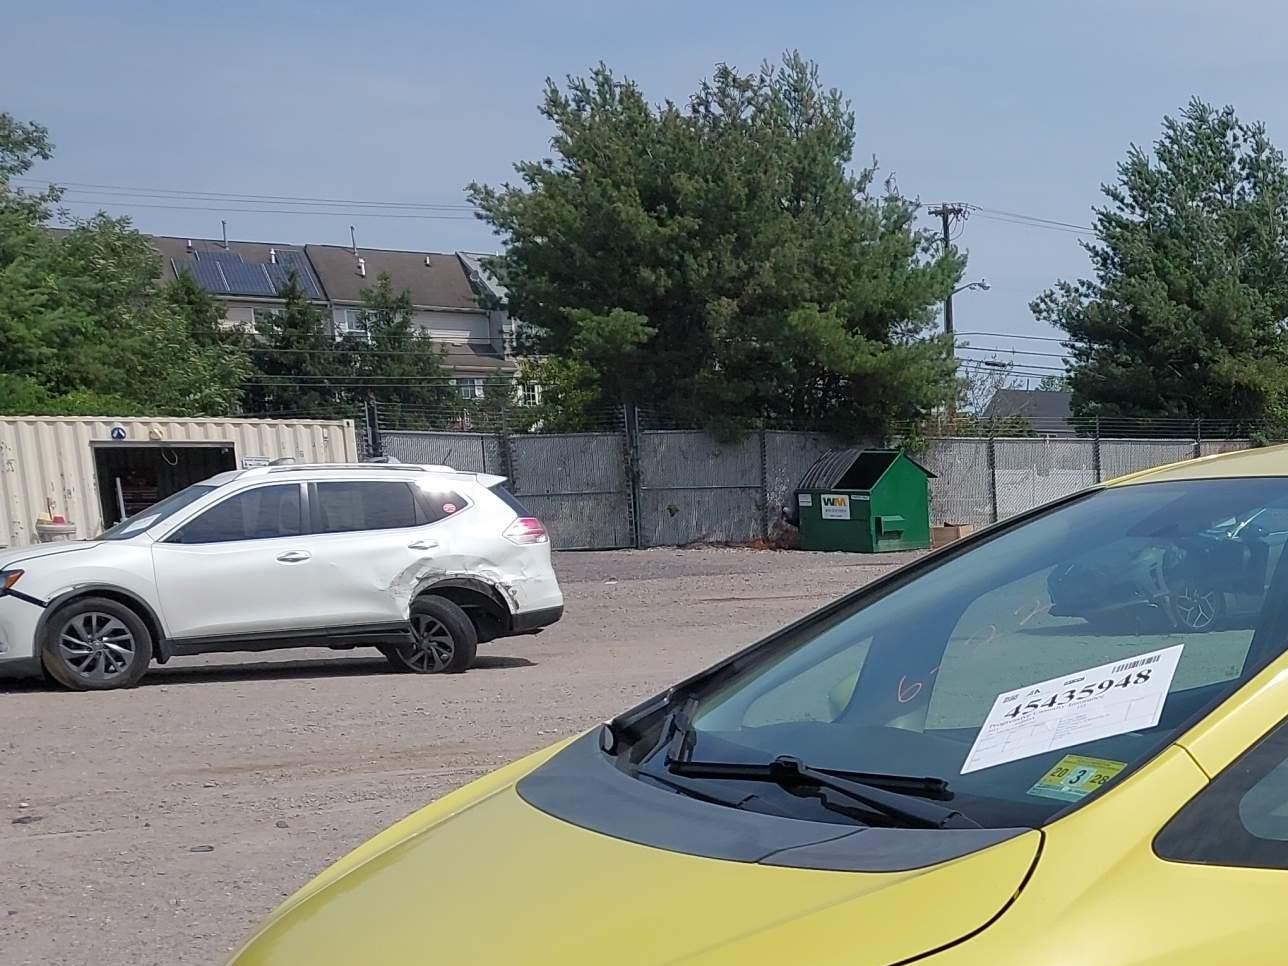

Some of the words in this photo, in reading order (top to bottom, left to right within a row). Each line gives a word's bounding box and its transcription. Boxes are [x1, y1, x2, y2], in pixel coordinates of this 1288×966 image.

[823, 497, 847, 507] WM
[1004, 668, 1152, 719] 45435948
[1050, 767, 1069, 778] 20
[1069, 769, 1087, 785] 3
[1089, 774, 1110, 786] 28
